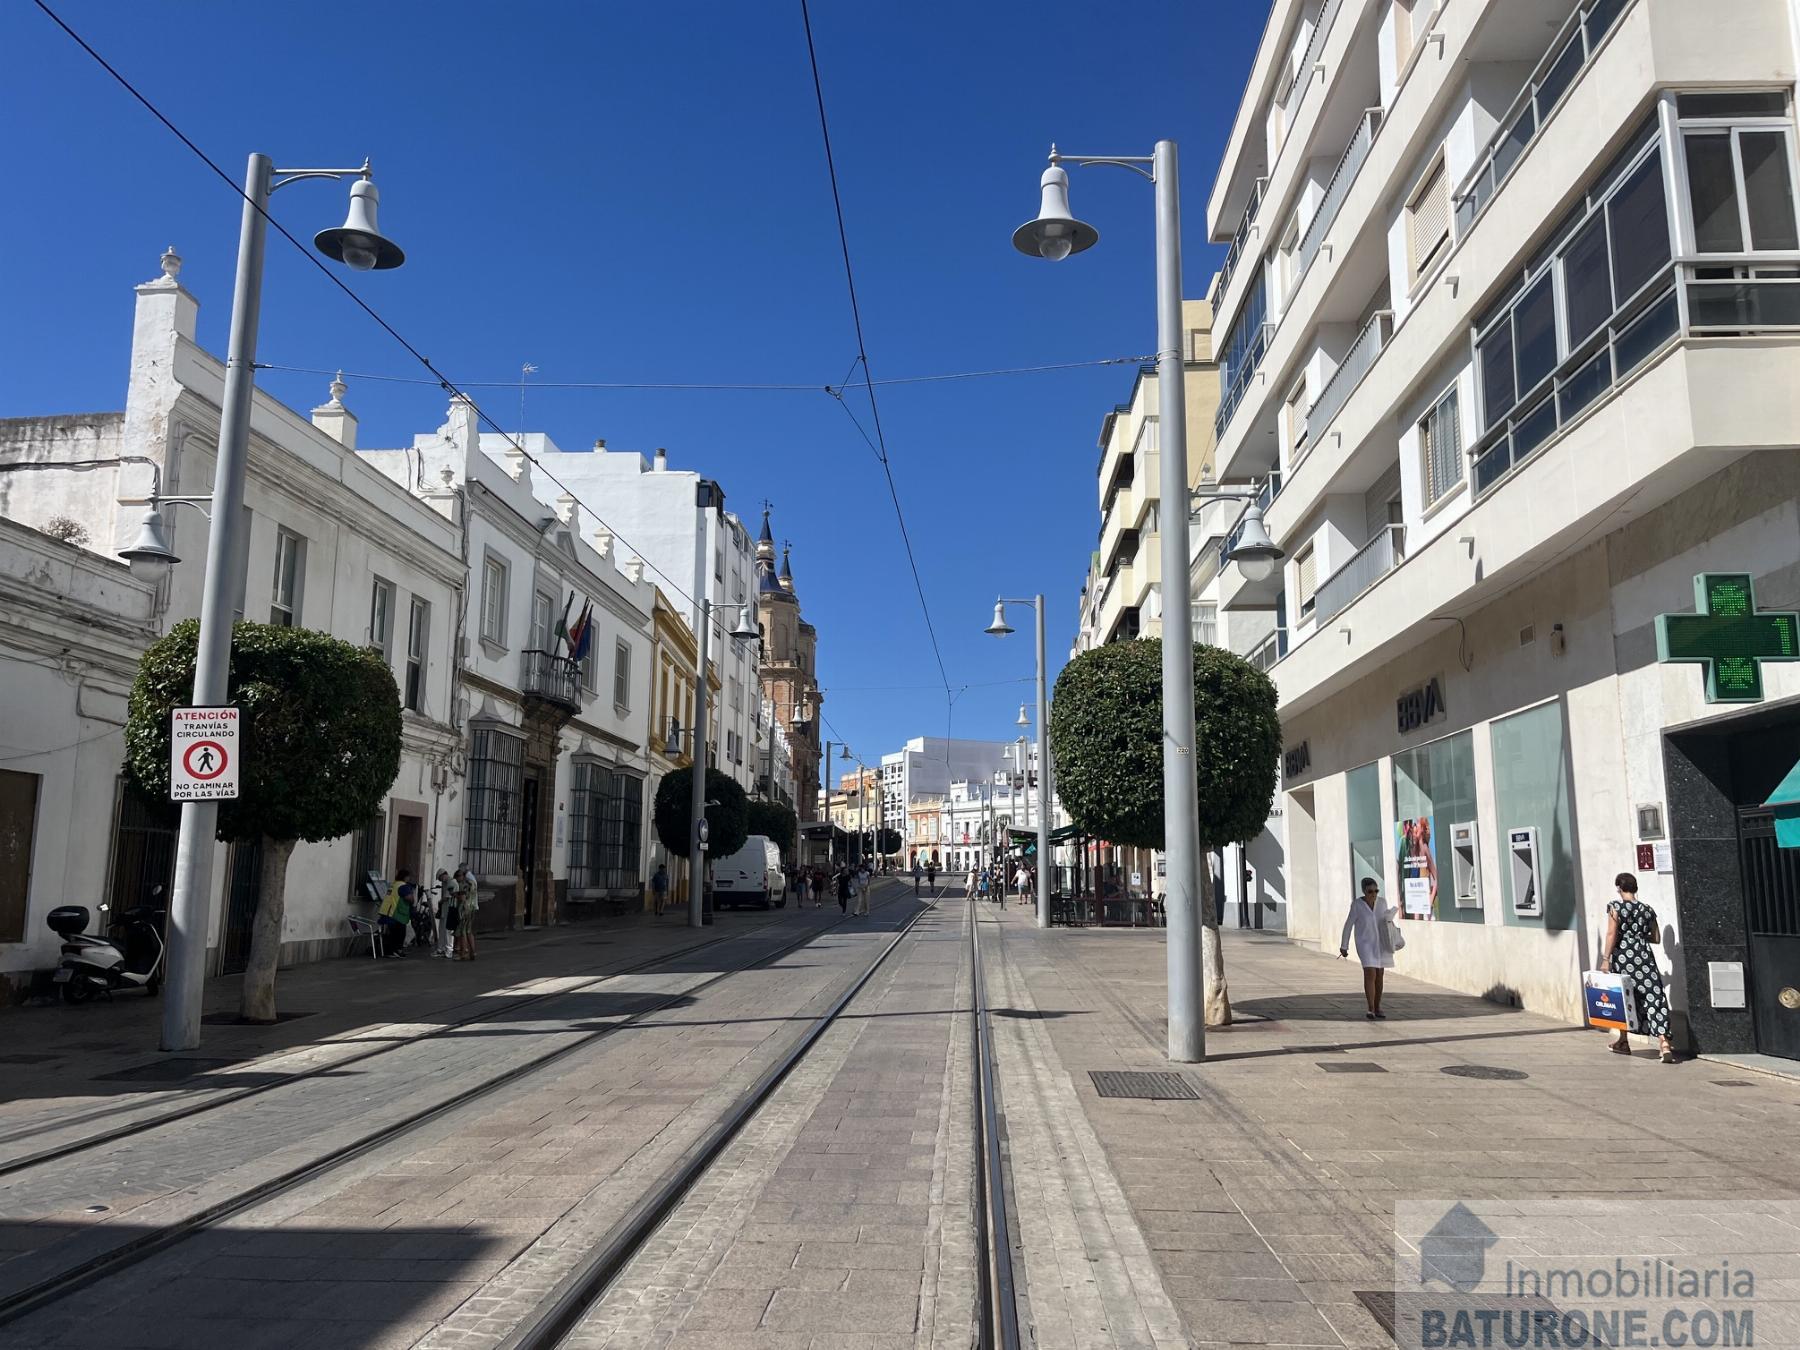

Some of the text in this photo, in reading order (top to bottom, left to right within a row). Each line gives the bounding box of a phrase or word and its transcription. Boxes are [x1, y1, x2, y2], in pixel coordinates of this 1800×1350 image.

[1397, 677, 1445, 733] BBVA
[175, 710, 237, 720] ATENCIÓN
[184, 722, 228, 730] TRANVÍAS
[1285, 741, 1310, 779] BBVA
[216, 788, 236, 797] VÍAS
